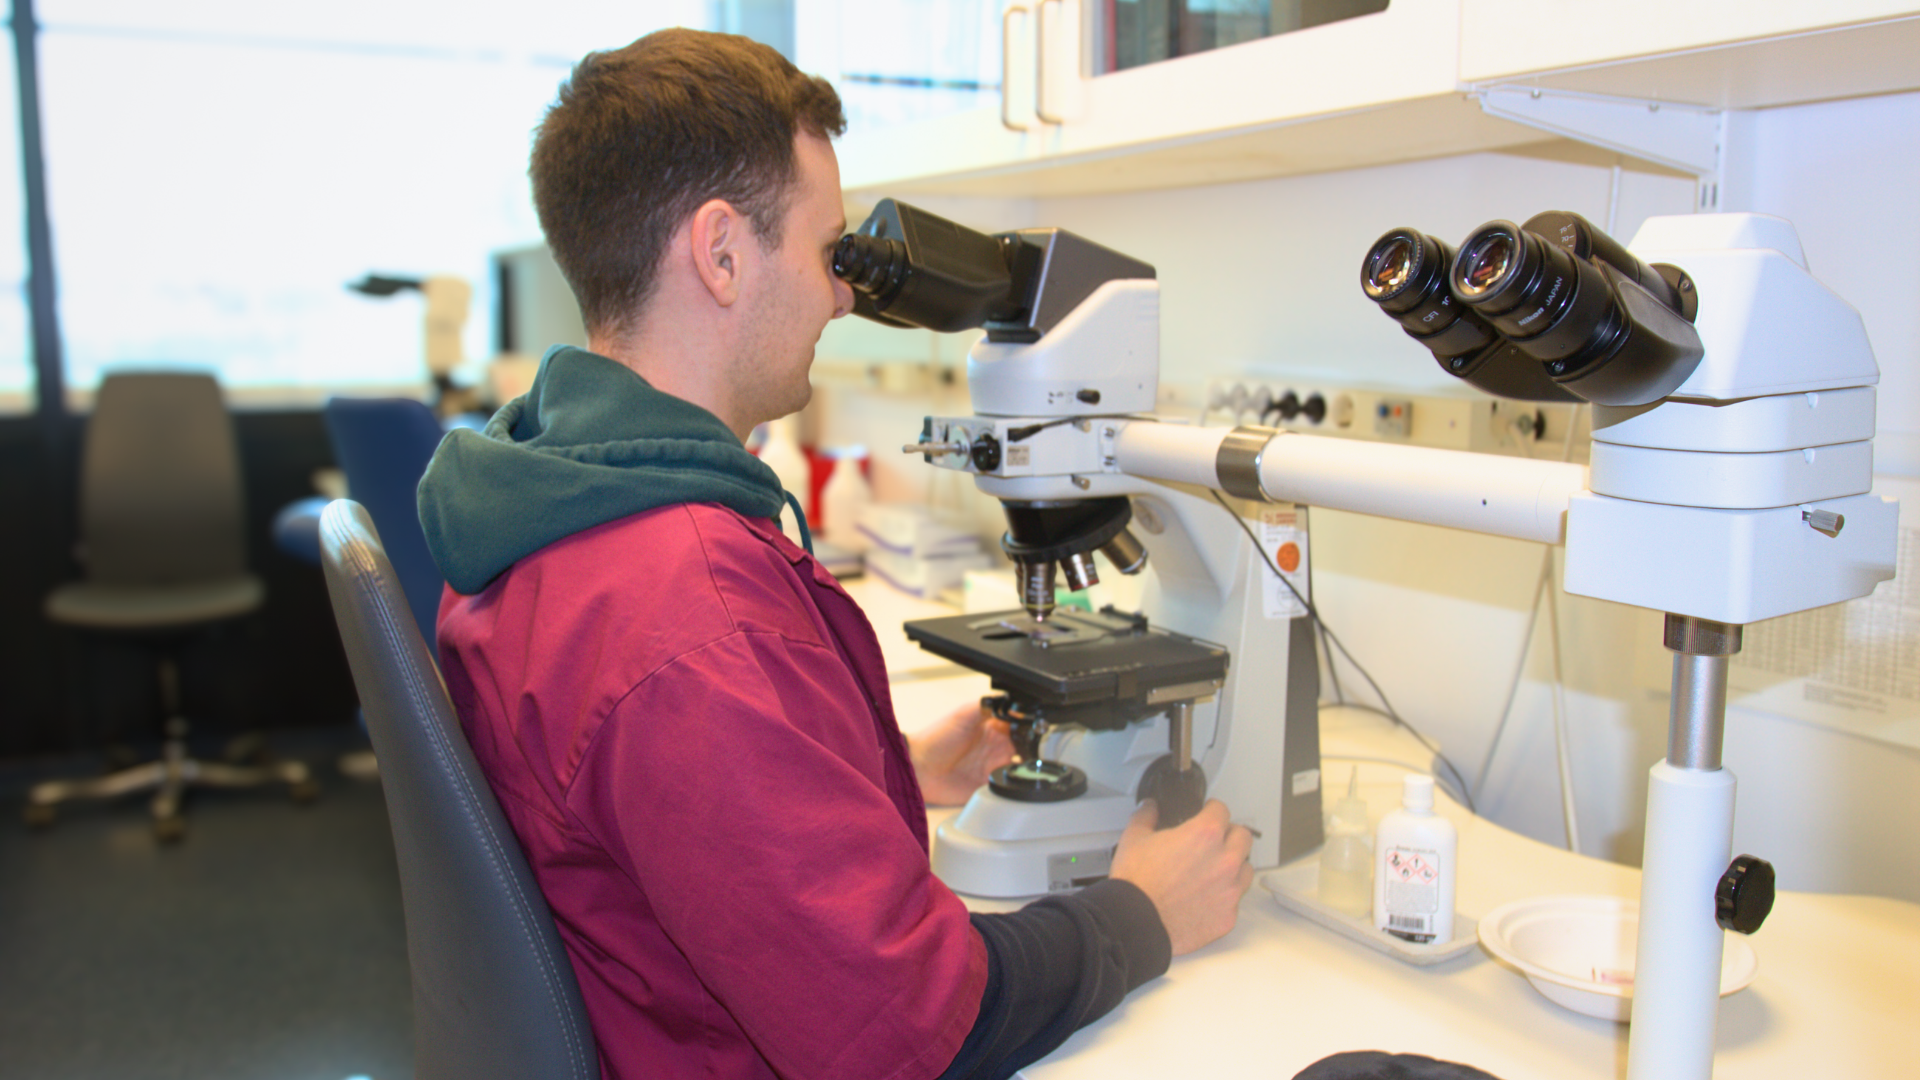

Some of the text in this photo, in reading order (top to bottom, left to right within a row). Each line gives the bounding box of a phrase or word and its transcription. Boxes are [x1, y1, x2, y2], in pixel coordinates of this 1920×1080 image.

[1423, 310, 1439, 322] CFI
[1518, 276, 1562, 326] Nikon JAPAN
